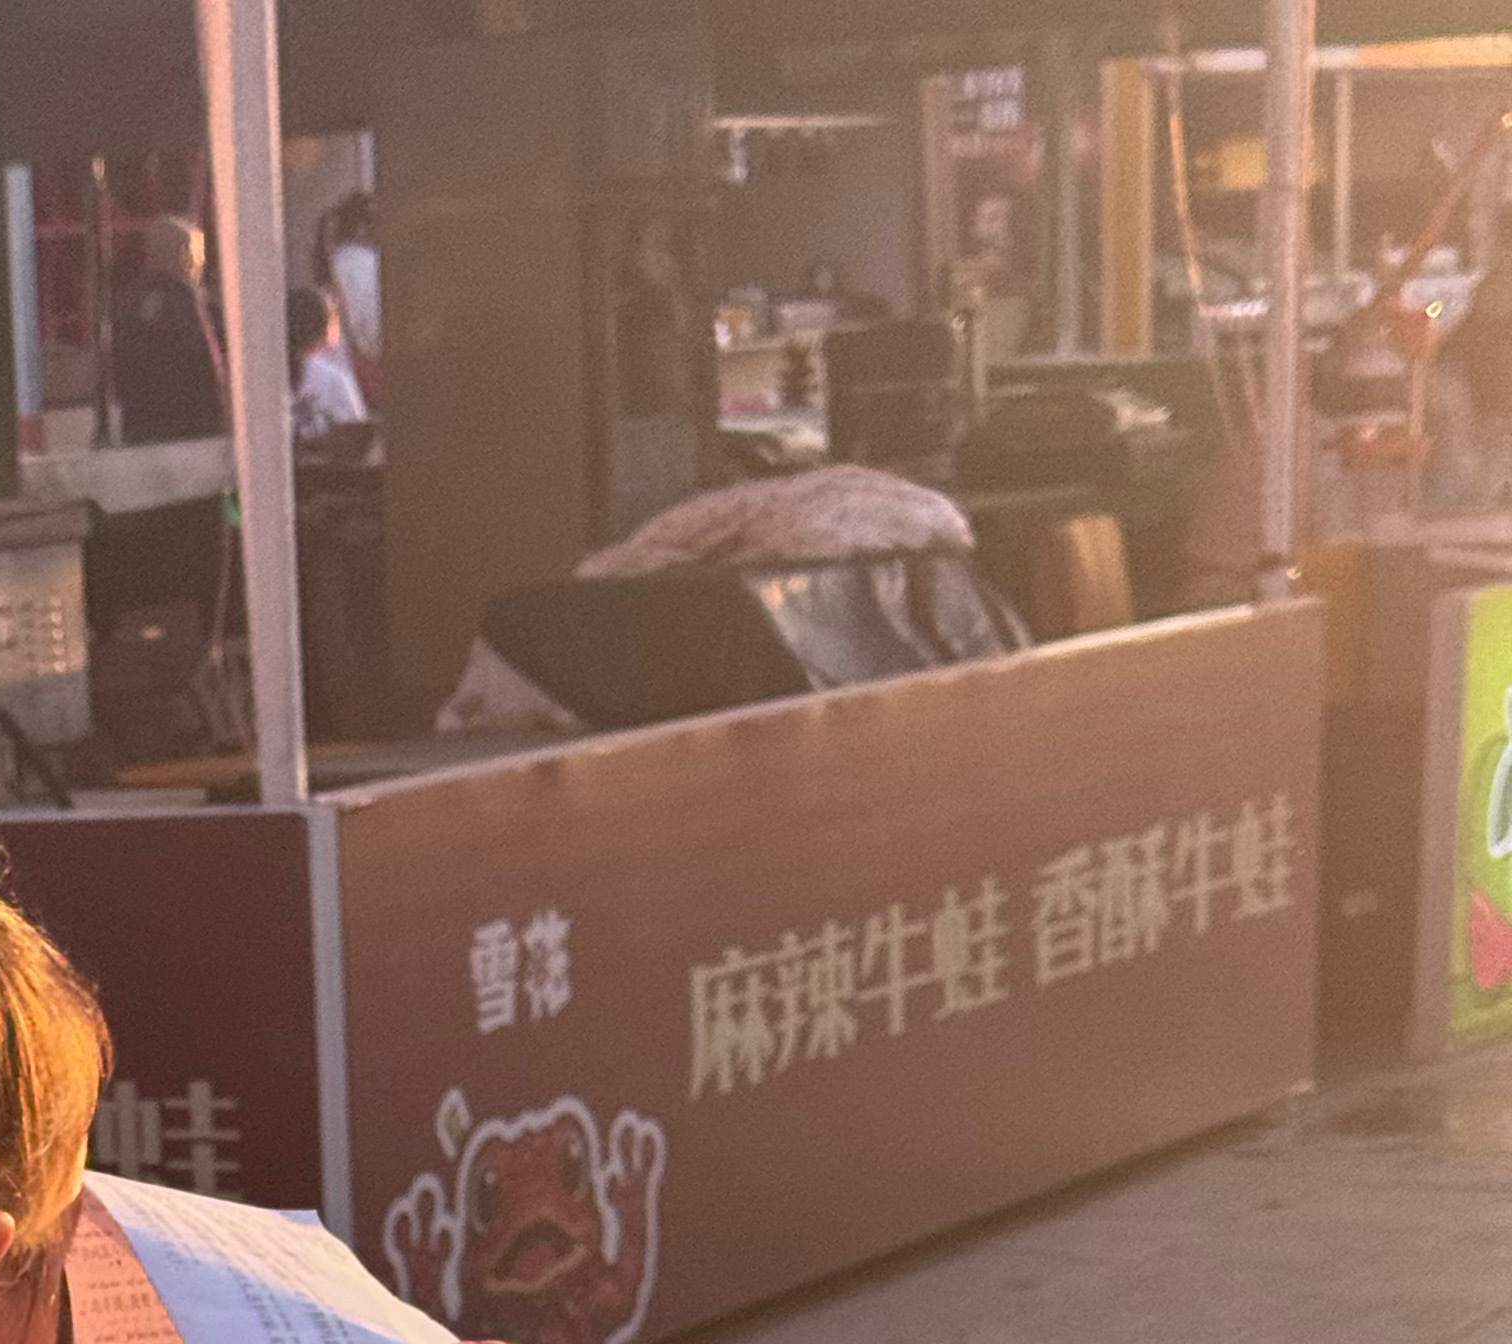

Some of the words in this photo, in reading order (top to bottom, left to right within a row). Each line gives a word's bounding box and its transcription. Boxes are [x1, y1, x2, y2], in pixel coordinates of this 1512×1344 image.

[470, 908, 573, 1035] 雪花
[689, 874, 1010, 1100] 麻辣牛蛙
[1031, 794, 1295, 984] 香酥牛蛙
